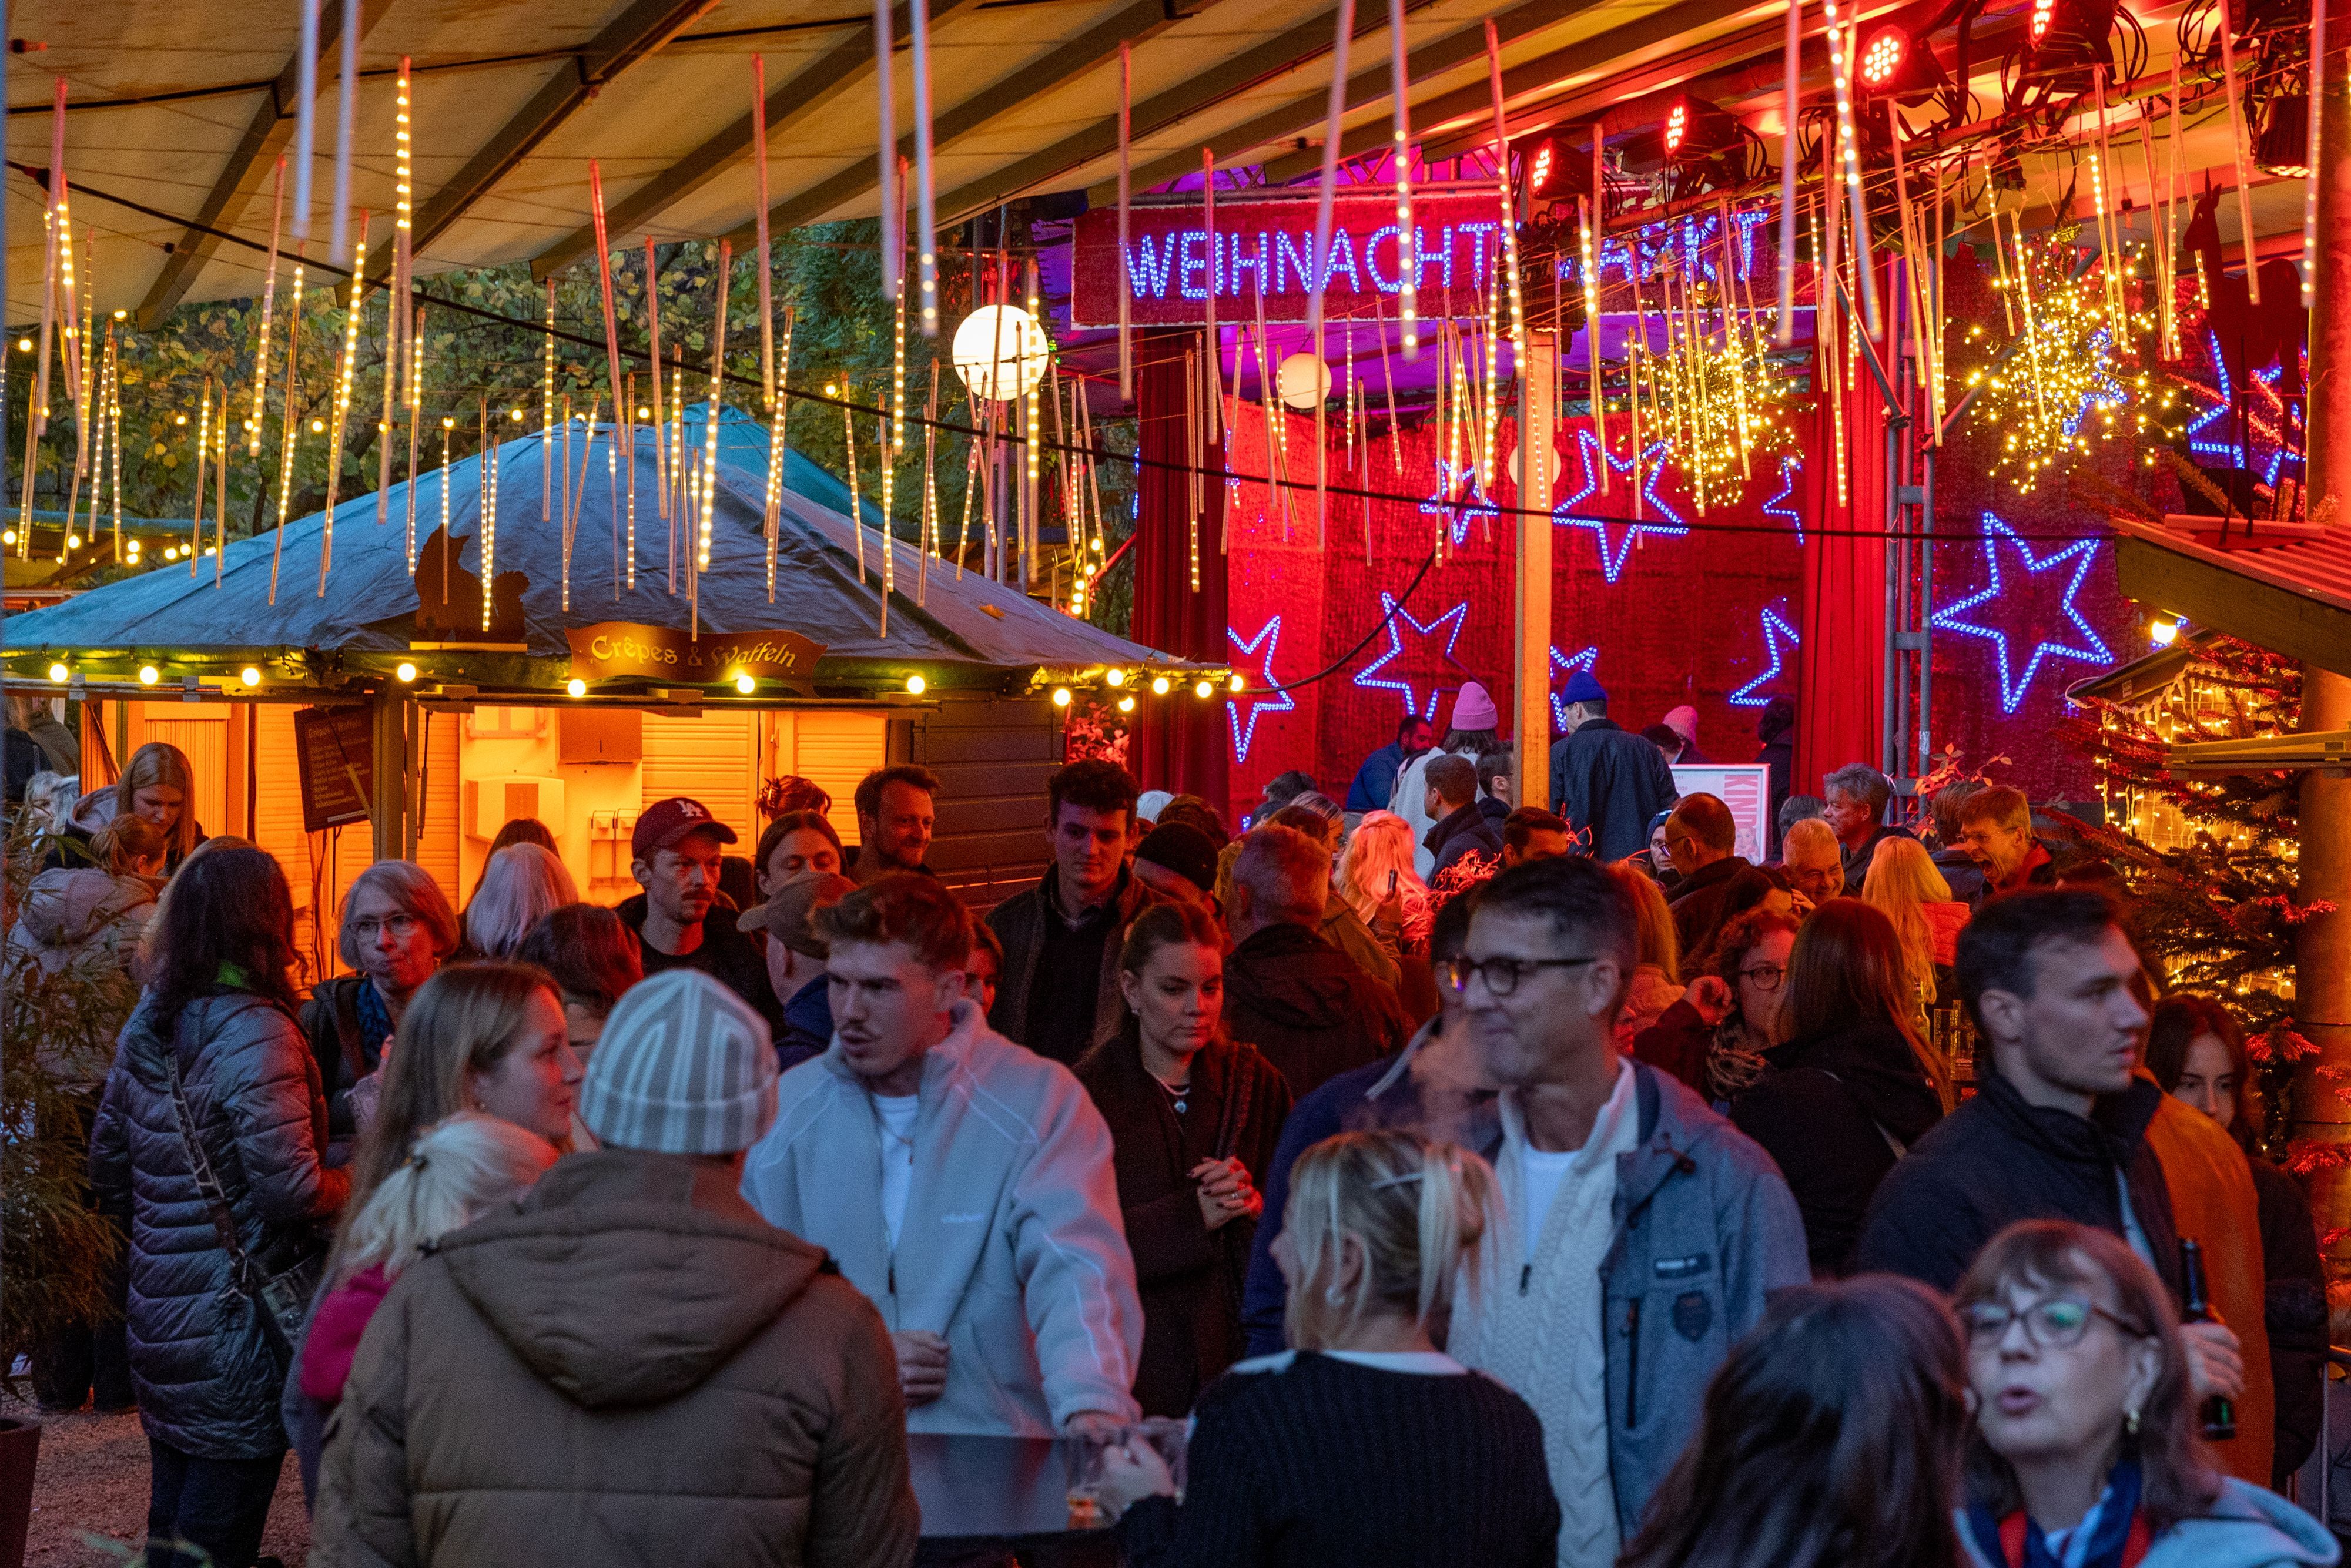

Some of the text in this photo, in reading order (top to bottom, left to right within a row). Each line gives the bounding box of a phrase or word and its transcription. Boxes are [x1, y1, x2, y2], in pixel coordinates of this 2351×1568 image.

[591, 635, 796, 668] Crêpes & Waffeln
[676, 800, 704, 817] LA
